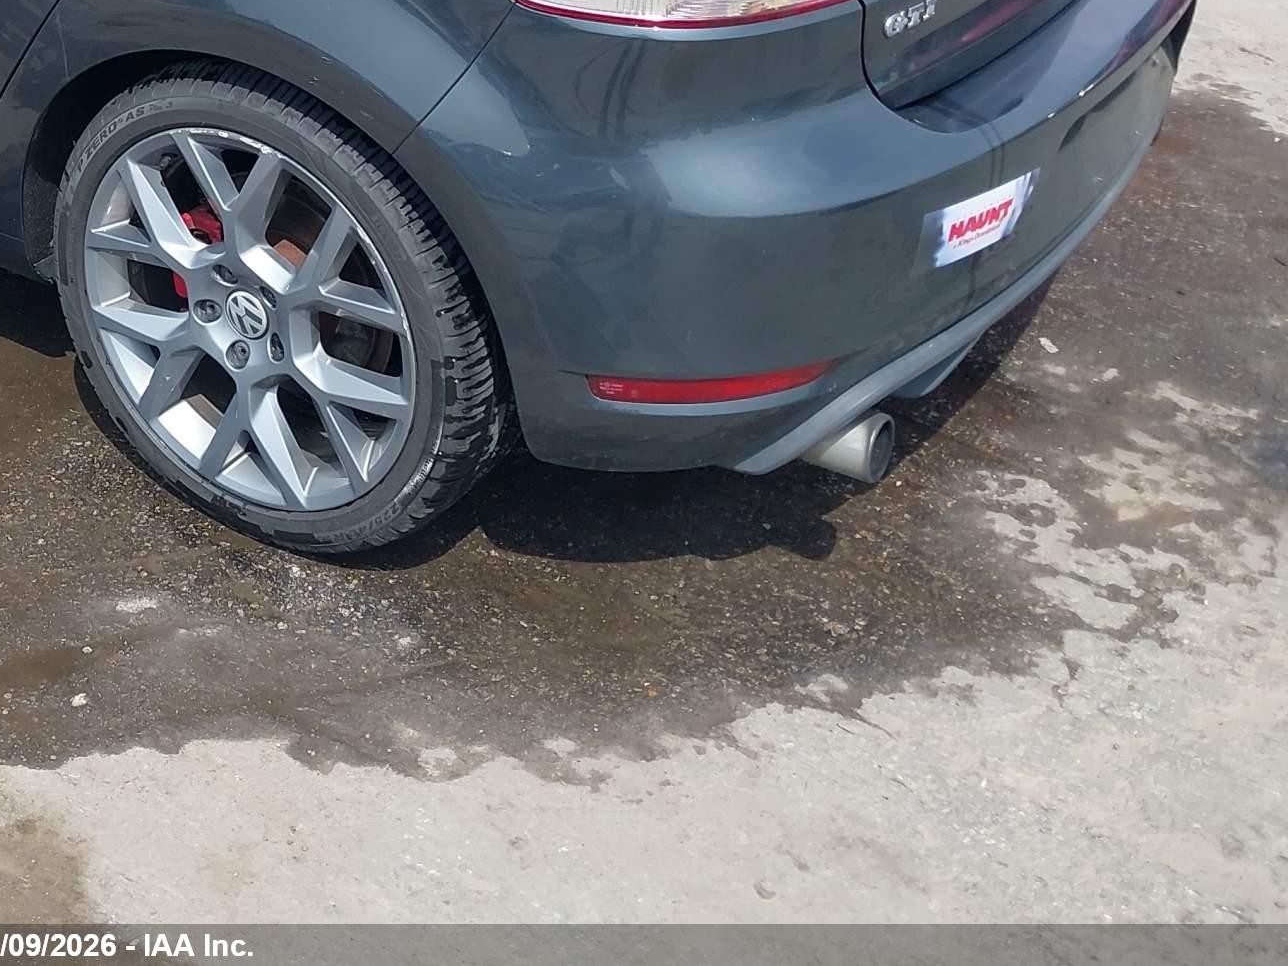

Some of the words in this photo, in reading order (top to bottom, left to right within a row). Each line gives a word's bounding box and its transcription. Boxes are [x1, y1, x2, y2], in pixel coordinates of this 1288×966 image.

[85, 120, 118, 160] ZERO
[126, 106, 145, 122] AS
[948, 197, 1014, 243] HAUNT
